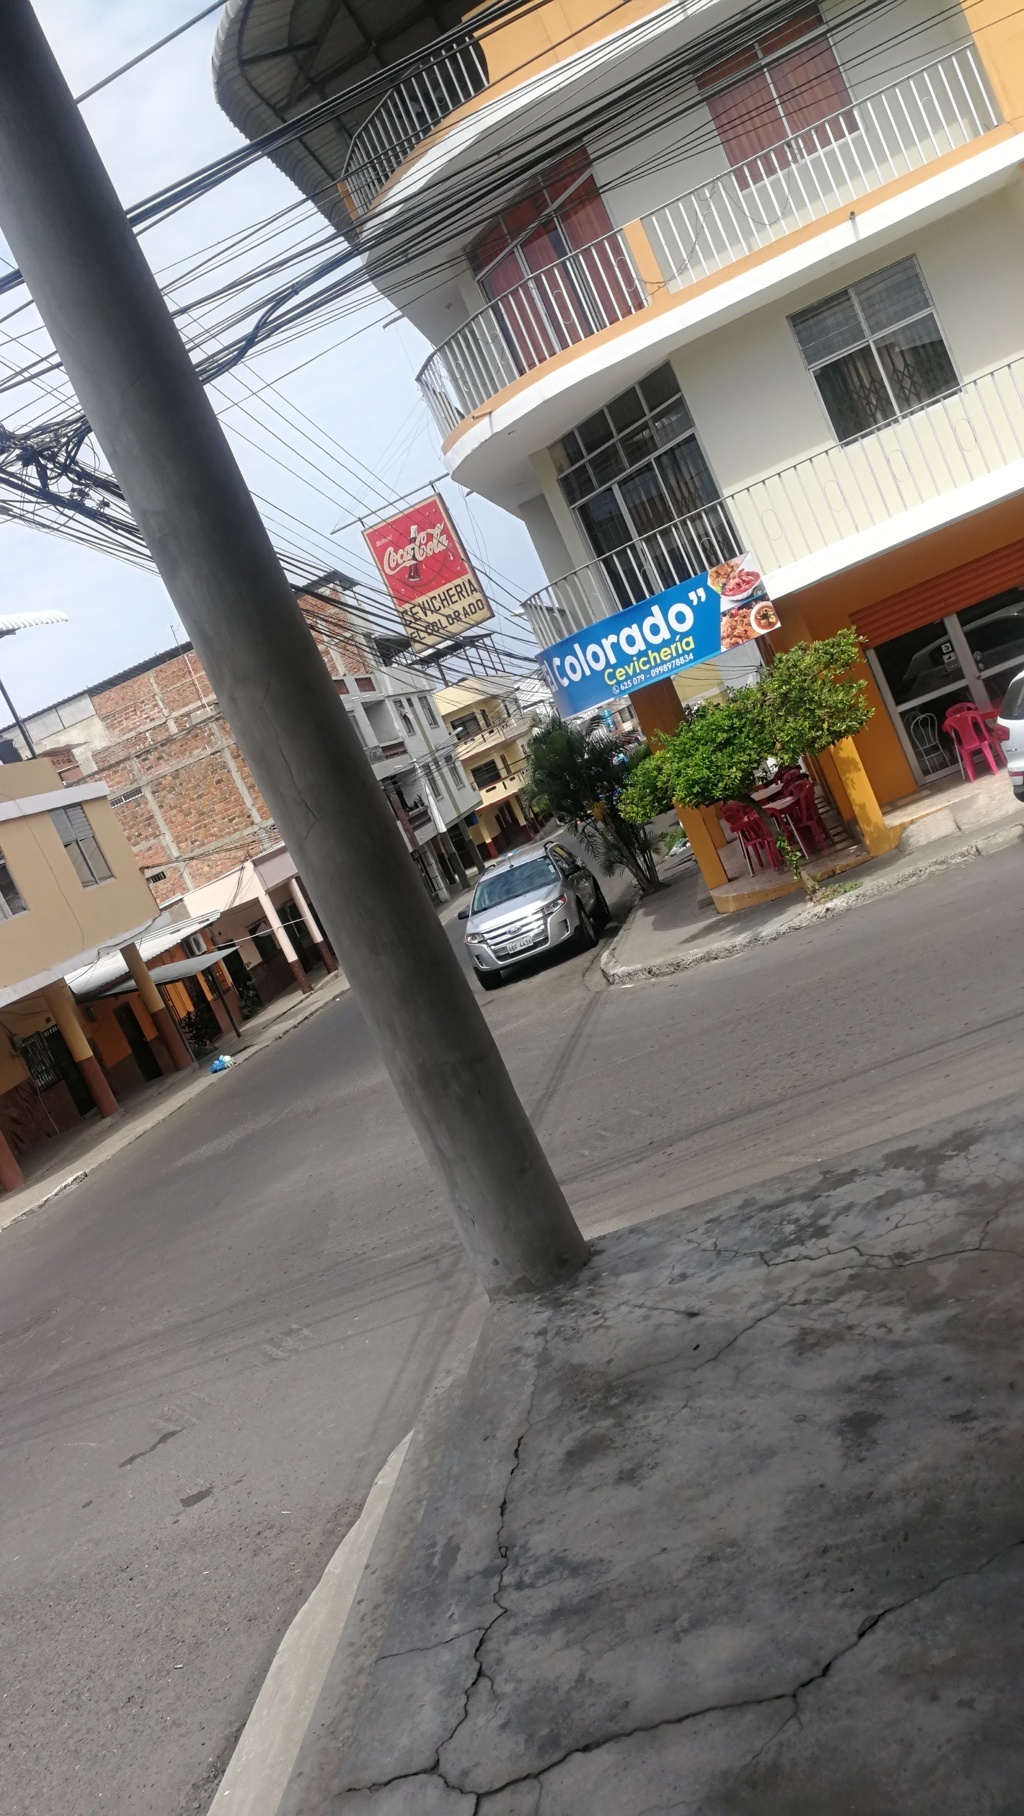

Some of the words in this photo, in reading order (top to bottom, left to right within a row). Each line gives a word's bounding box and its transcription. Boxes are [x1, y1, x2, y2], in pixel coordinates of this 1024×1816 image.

[401, 578, 478, 625] CEVICHERIA
[409, 629, 426, 641] EL
[425, 598, 485, 636] COLORADO
[604, 634, 695, 686] Cevichería
[620, 681, 632, 691] 625
[633, 674, 645, 685] 079
[650, 652, 694, 677] 0998978834
